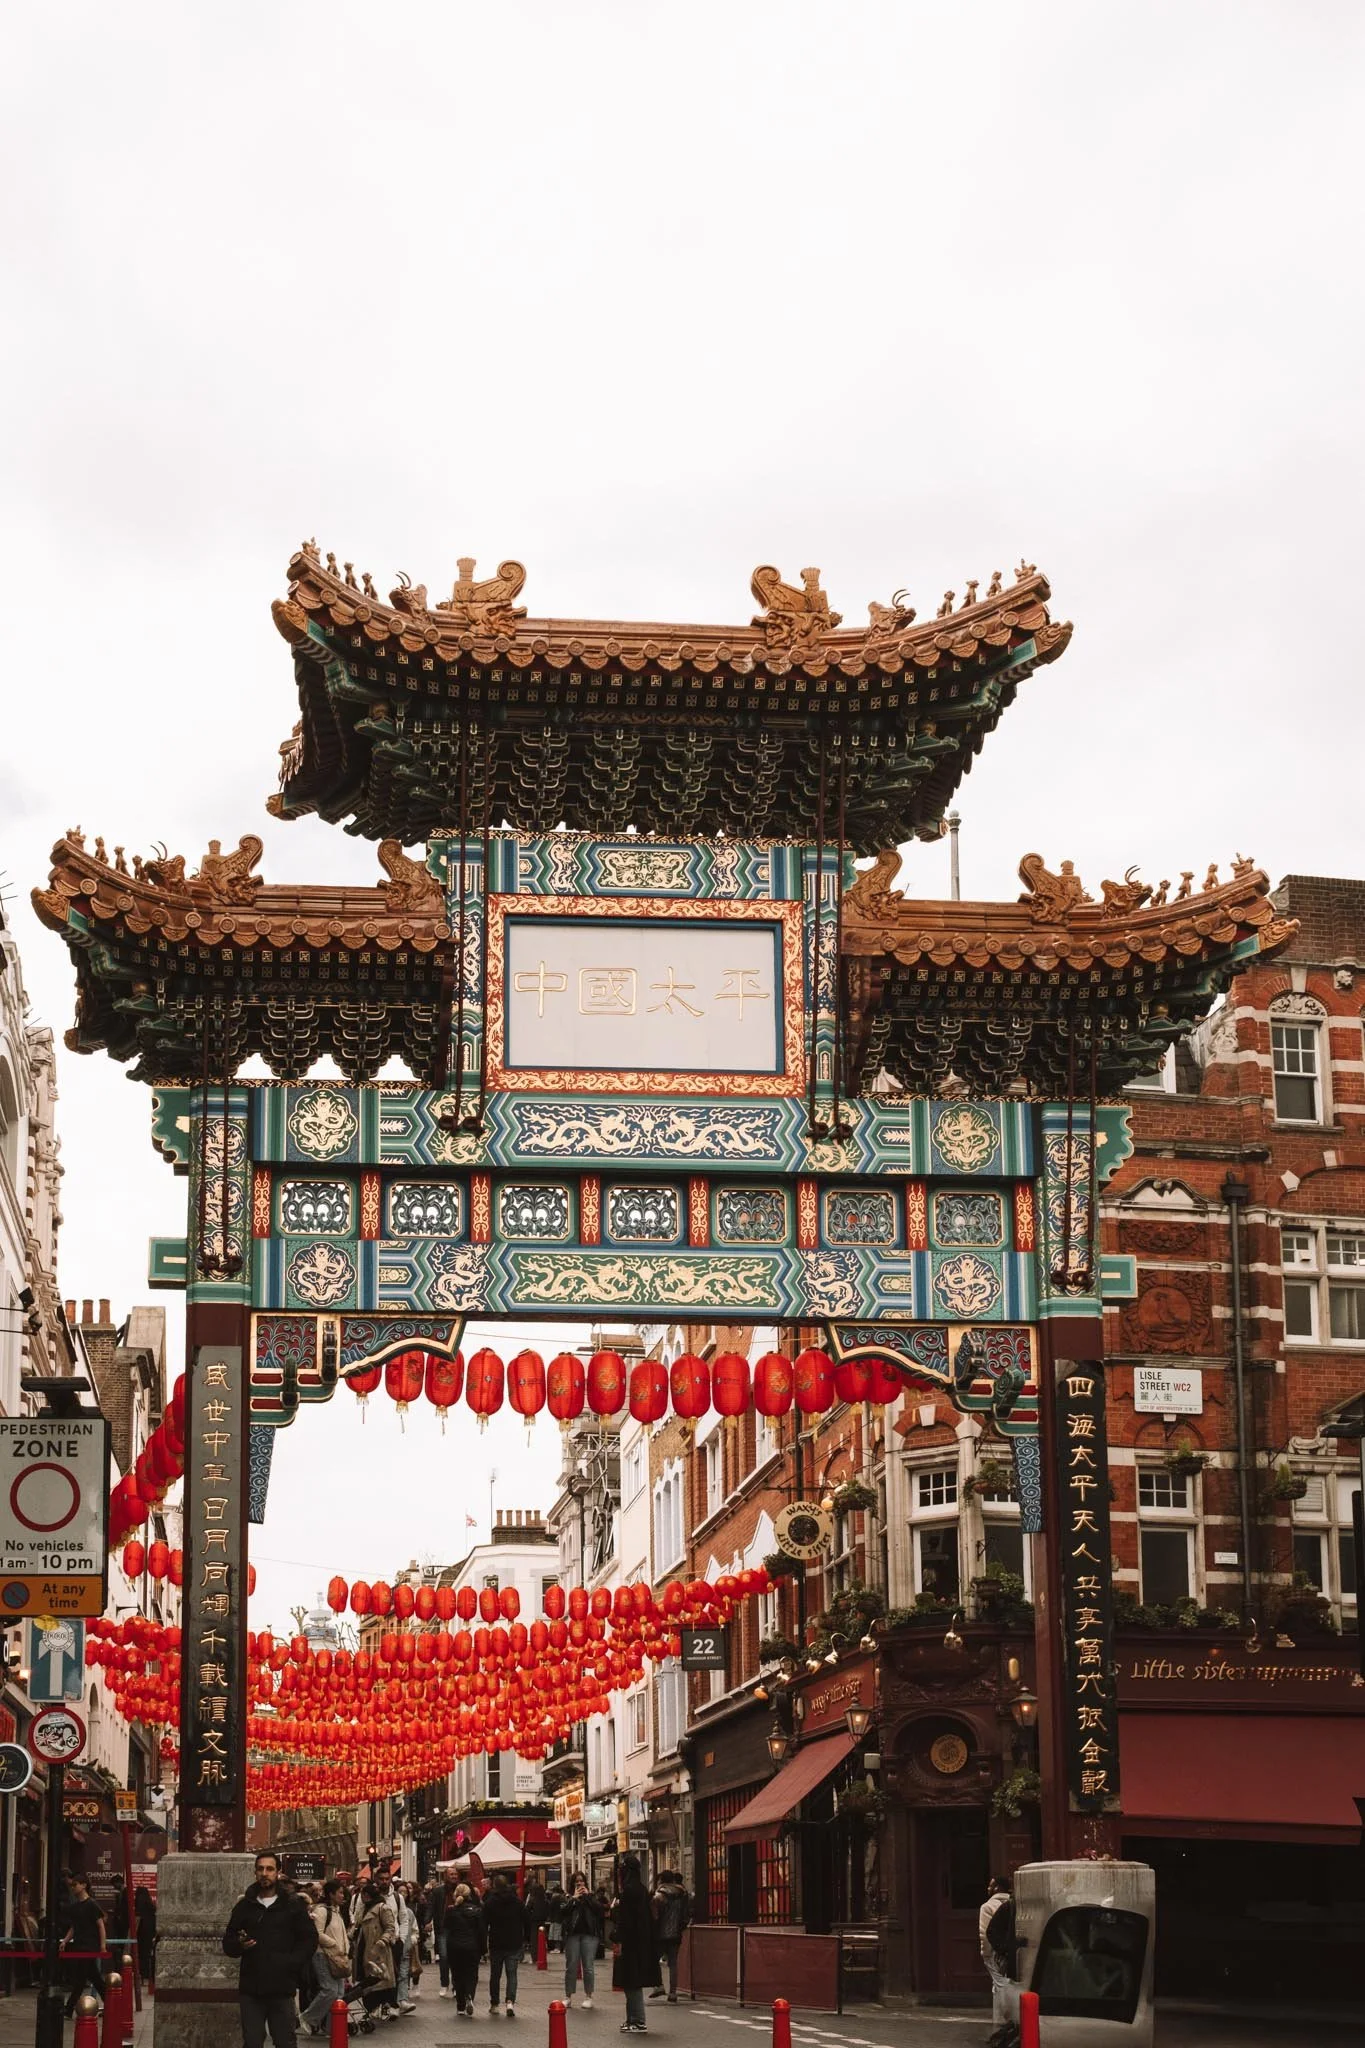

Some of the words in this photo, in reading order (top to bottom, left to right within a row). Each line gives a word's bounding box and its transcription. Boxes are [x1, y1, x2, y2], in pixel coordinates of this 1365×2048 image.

[513, 960, 770, 1021] 中國太平
[1140, 1371, 1162, 1380] LISLE
[1140, 1381, 1170, 1391] STREET
[1174, 1383, 1191, 1392] WC2
[0, 1424, 93, 1435] PEDESTRIAN
[12, 1440, 79, 1457] ZONE
[5, 1540, 24, 1551] No
[29, 1540, 84, 1551] vehicles
[41, 1554, 62, 1569] 10
[66, 1557, 93, 1571] pm
[42, 1583, 58, 1594] At
[62, 1585, 86, 1598] any
[49, 1597, 79, 1608] time
[692, 1638, 715, 1654] 22
